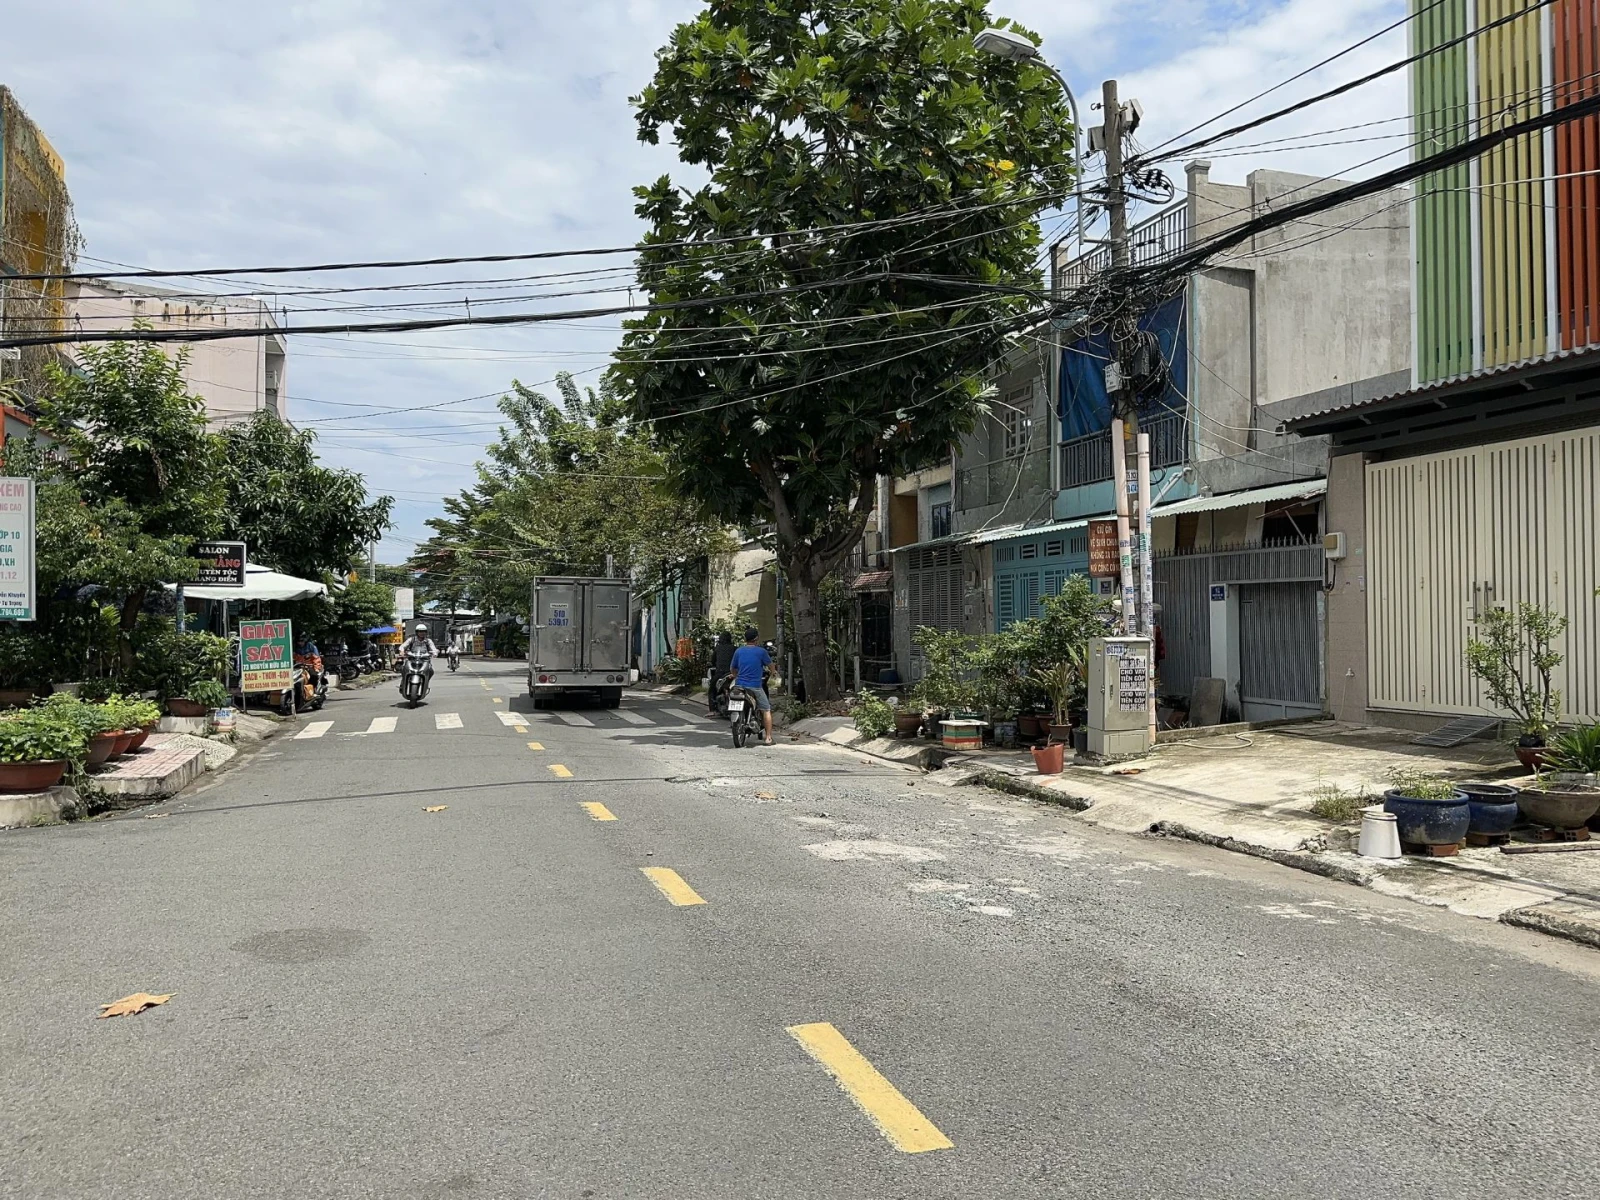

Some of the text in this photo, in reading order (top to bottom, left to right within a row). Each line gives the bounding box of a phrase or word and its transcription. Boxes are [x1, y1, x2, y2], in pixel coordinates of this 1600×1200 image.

[9, 503, 22, 512] CAO
[11, 531, 21, 540] 10
[198, 546, 230, 554] SALON
[242, 621, 287, 641] GIẬT
[246, 642, 284, 662] SẤY
